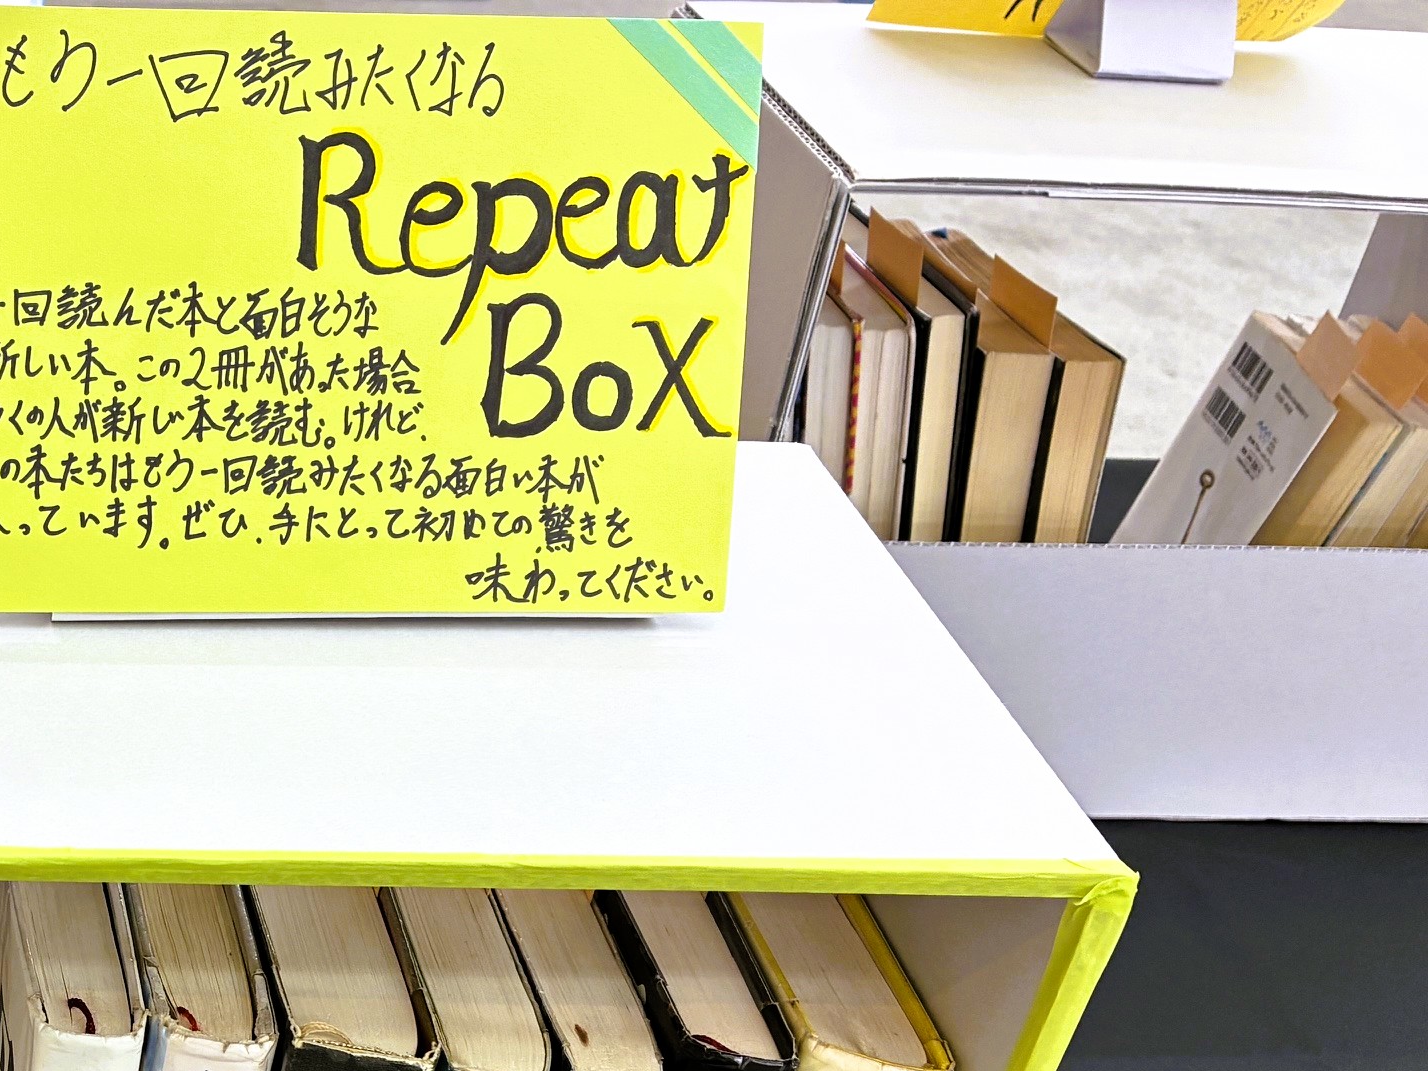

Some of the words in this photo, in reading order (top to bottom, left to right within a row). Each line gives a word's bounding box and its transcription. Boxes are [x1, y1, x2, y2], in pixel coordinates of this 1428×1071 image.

[2, 28, 506, 122] もう一回読みたくなる
[295, 130, 750, 346] Repeat
[465, 556, 718, 605] 味わってください。
